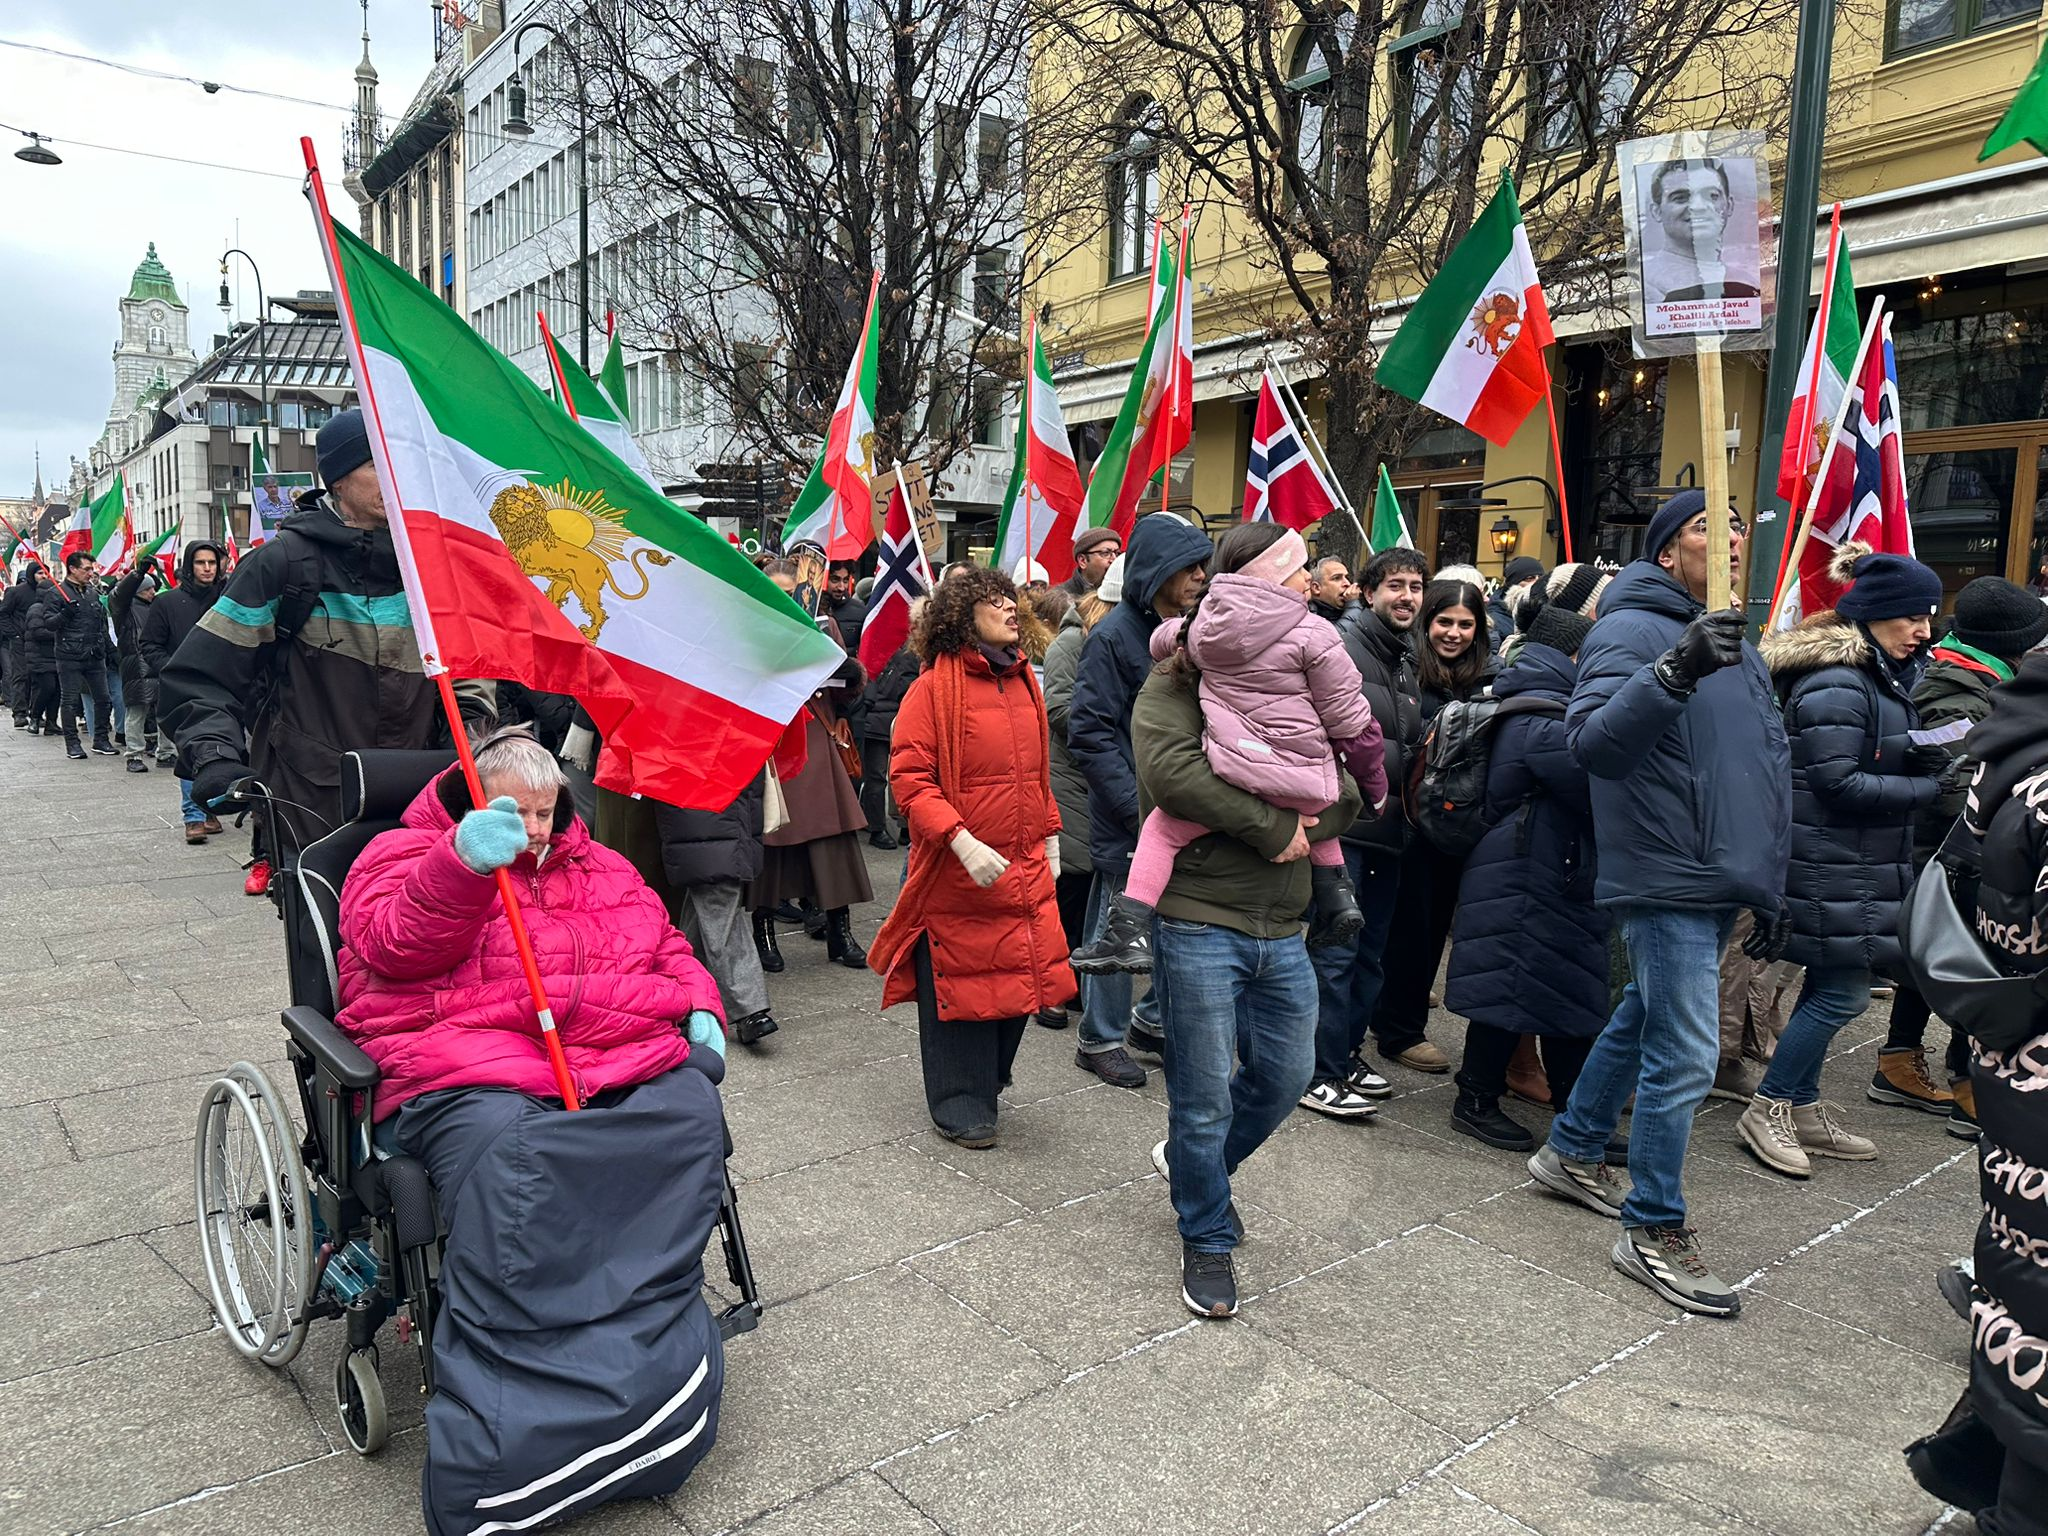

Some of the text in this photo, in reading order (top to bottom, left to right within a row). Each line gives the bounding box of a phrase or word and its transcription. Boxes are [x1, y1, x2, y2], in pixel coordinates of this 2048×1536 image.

[1656, 301, 1749, 312] Mohammad Javad
[1669, 310, 1739, 321] Khalili Ardali
[1673, 321, 1697, 329] Killed
[875, 478, 923, 515] STTT
